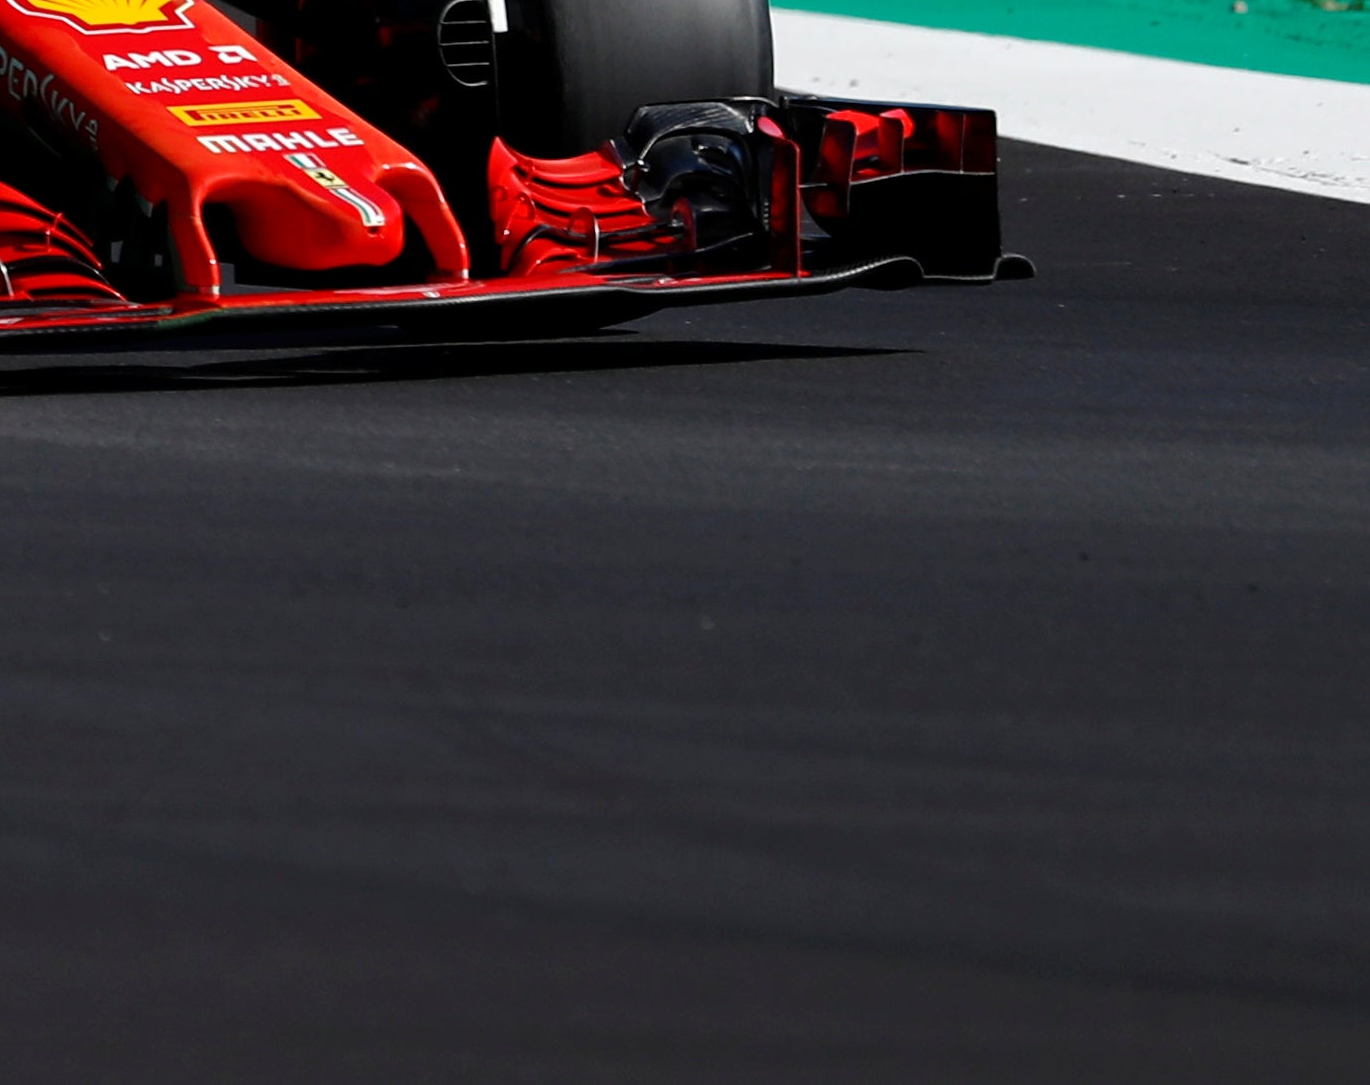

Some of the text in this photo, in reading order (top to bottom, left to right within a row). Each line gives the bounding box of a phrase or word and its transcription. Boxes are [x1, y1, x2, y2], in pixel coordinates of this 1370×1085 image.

[102, 49, 202, 71] AMD
[125, 74, 271, 94] KASPERSKY
[197, 127, 365, 154] MAHLE
